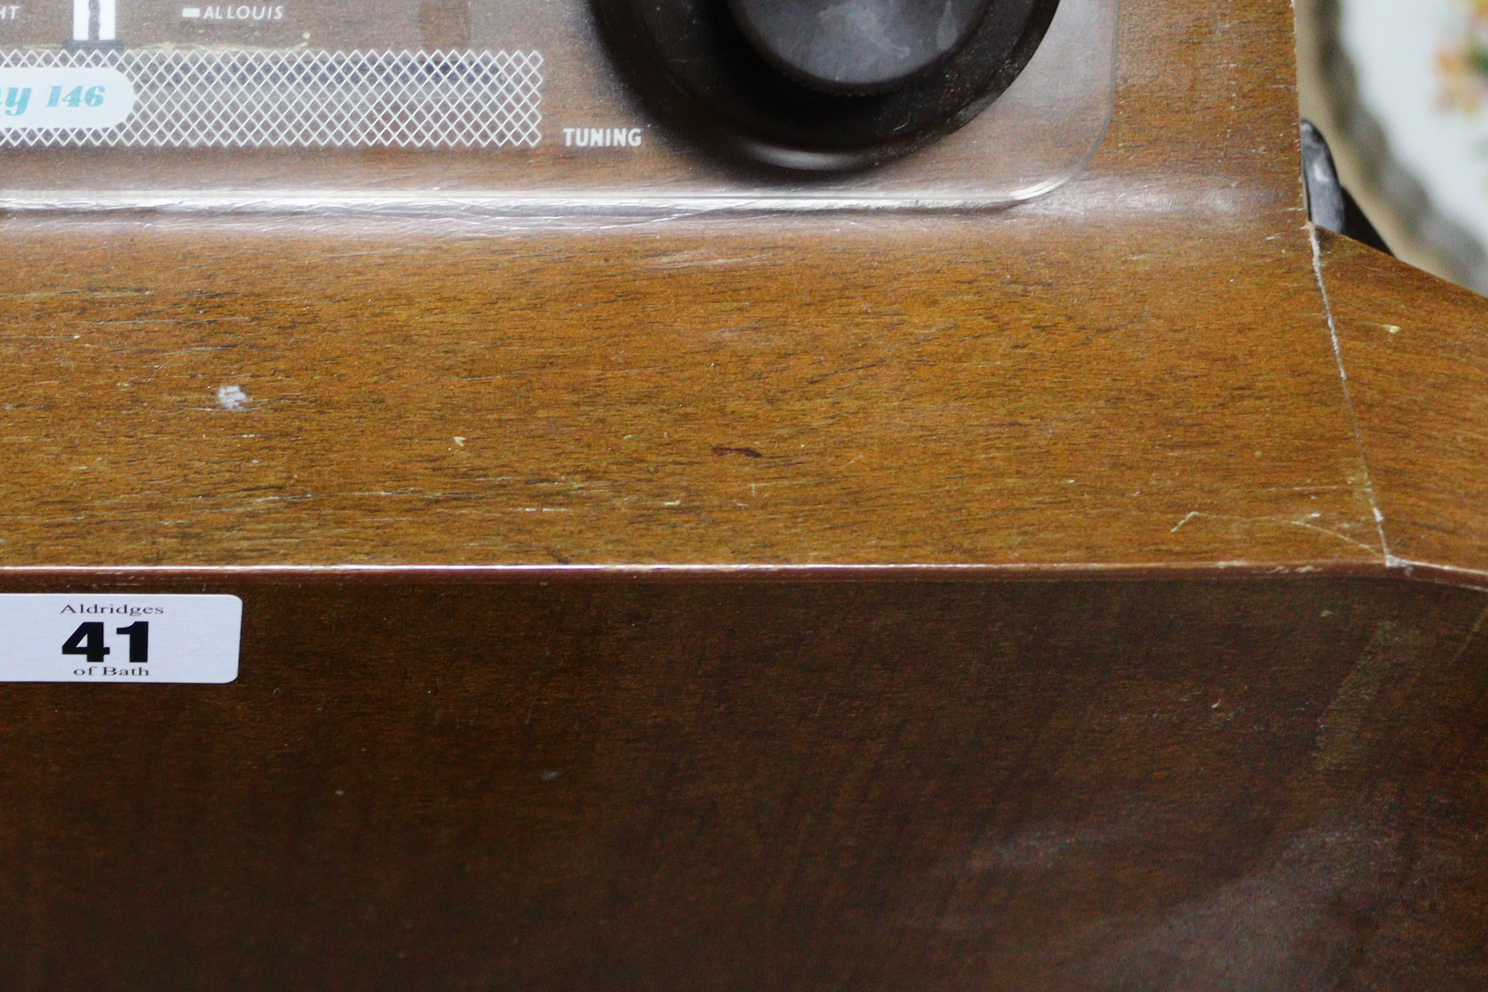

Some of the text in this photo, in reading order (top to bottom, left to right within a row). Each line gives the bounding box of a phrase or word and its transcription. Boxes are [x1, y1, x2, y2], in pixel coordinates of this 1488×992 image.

[202, 5, 283, 20] ALLOUIS
[45, 85, 106, 108] 146
[562, 127, 642, 147] TUNING
[60, 604, 164, 616] Aldridges
[62, 621, 149, 663] 41
[73, 666, 150, 677] of Bath
